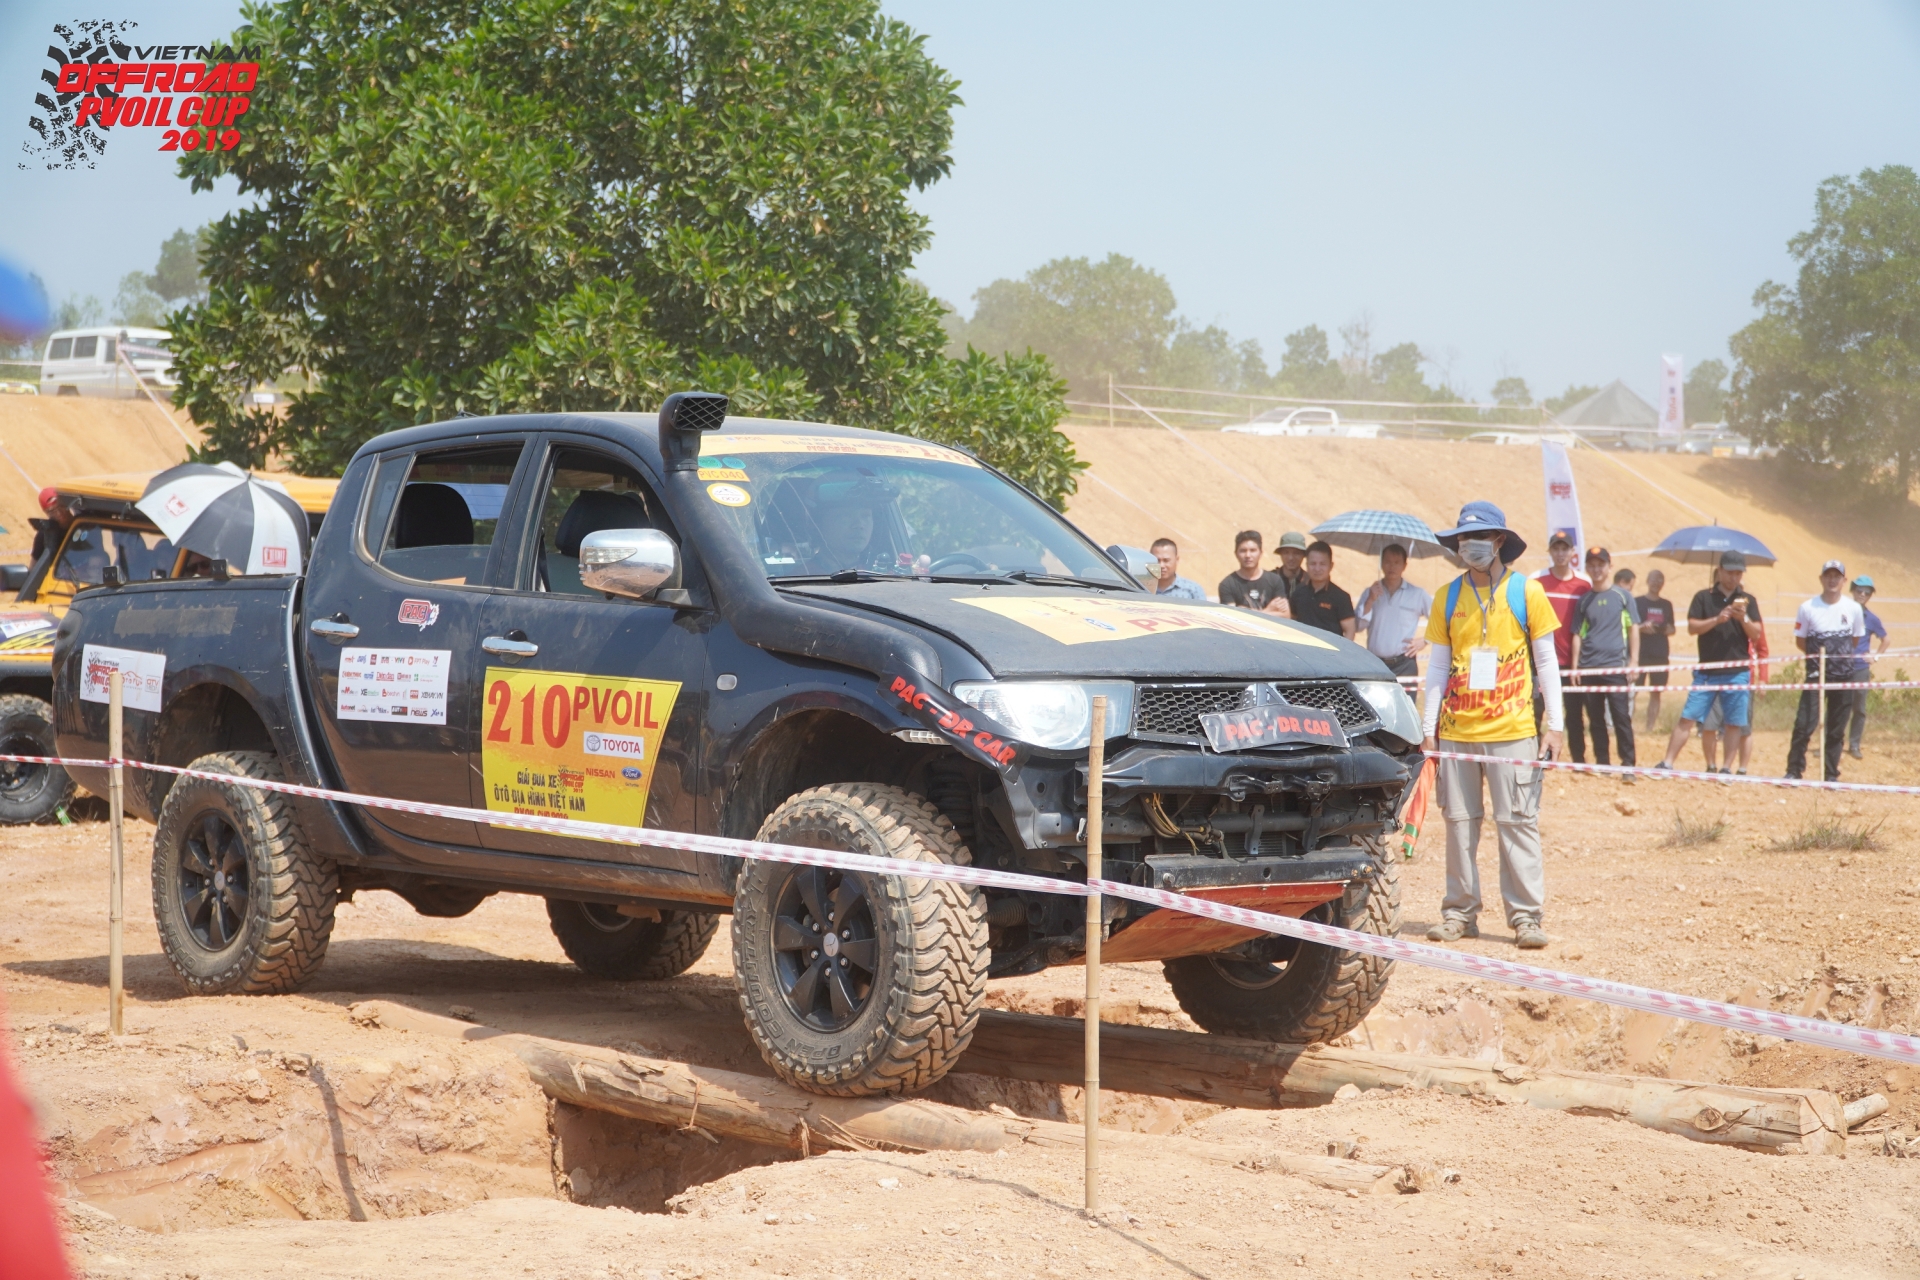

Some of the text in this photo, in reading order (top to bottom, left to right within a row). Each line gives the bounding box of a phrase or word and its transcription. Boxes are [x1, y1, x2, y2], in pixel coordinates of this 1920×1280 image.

[720, 471, 744, 479] 040
[402, 604, 428, 619] PAC
[1490, 679, 1525, 705] CUP
[486, 680, 659, 748] 210 PVOIL
[890, 676, 932, 710] PAC
[938, 710, 974, 738] DR
[973, 731, 1016, 766] CAR
[1483, 698, 1526, 720] 2019
[1224, 719, 1264, 741] PAC
[1276, 716, 1302, 734] DR
[1303, 720, 1333, 737] CAR
[602, 738, 641, 754] TOYOTA
[548, 774, 557, 788] XE
[585, 768, 616, 779] NISSAN
[528, 786, 546, 807] HÌNH
[548, 791, 566, 811] VIỆT
[568, 796, 585, 812] NAM
[164, 921, 196, 970] OPEN
[744, 897, 842, 1060] OPEN COUNTRY
